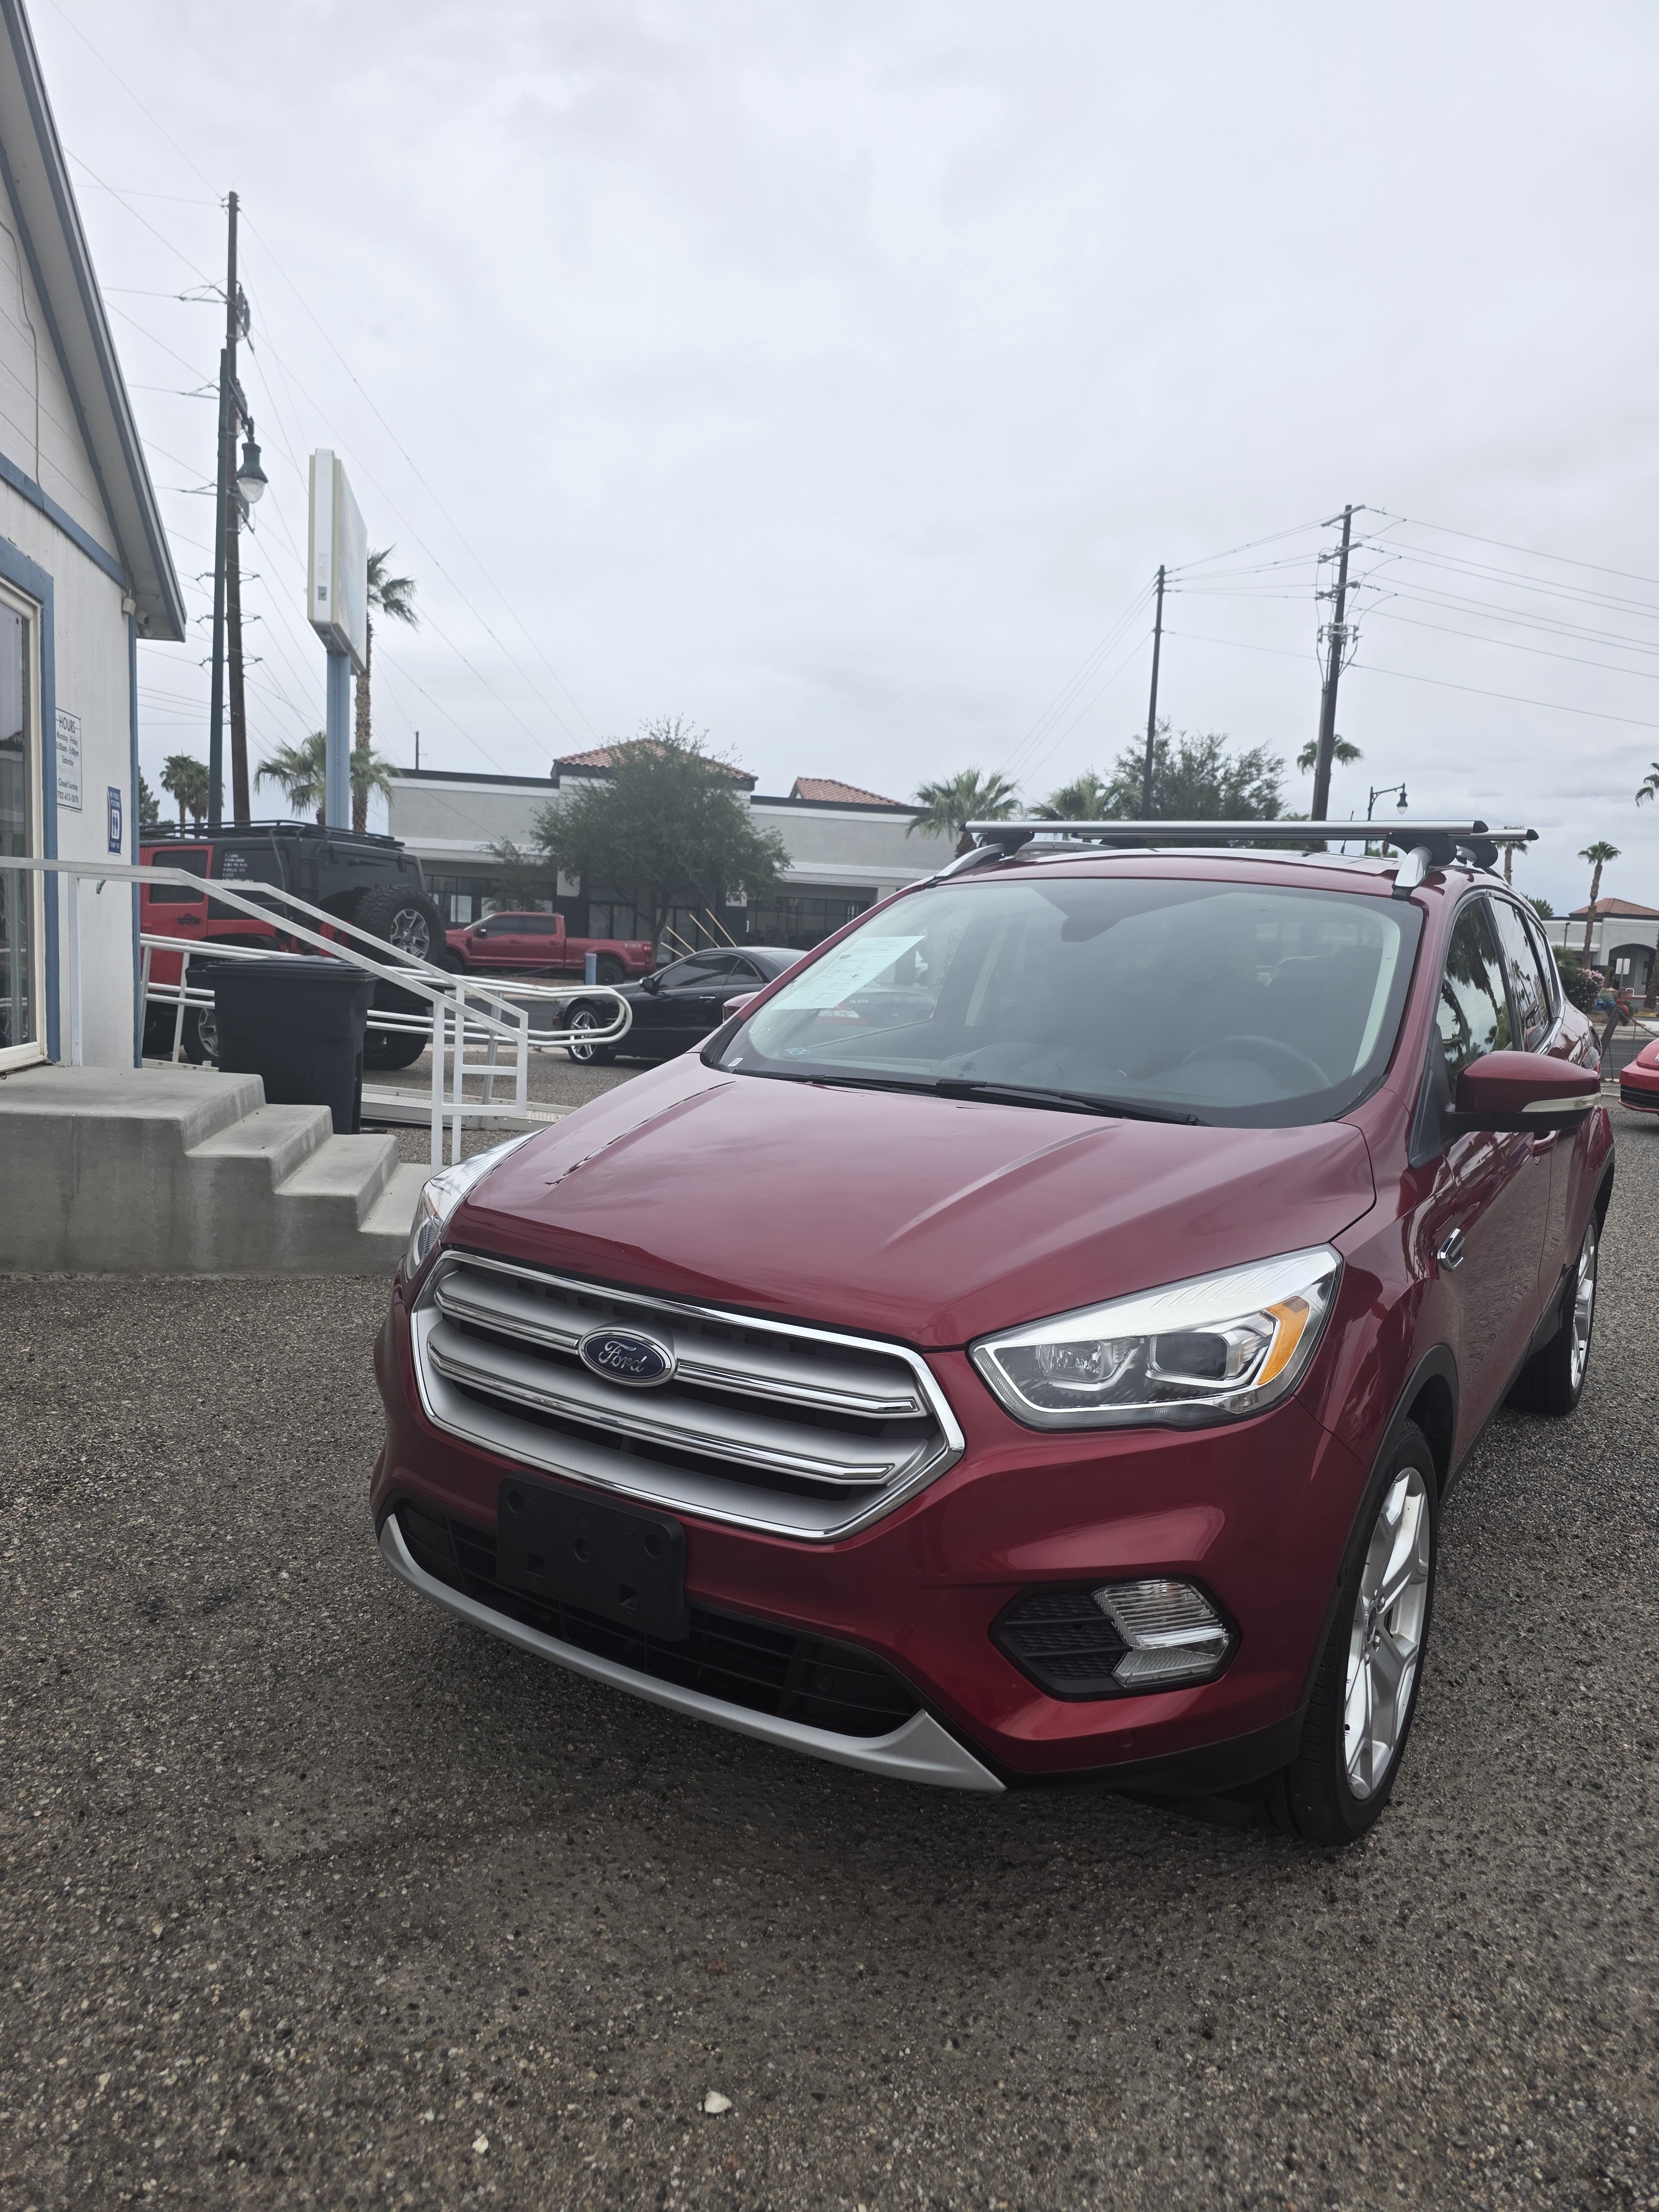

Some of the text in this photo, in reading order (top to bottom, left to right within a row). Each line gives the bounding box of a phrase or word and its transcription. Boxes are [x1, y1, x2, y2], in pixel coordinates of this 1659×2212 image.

[59, 714, 75, 734] HOURS
[56, 731, 68, 744] Monday
[70, 735, 78, 748] Friday
[62, 755, 74, 768] Saturday
[58, 778, 78, 792] Closed Sunday
[598, 1340, 648, 1373] Ford
